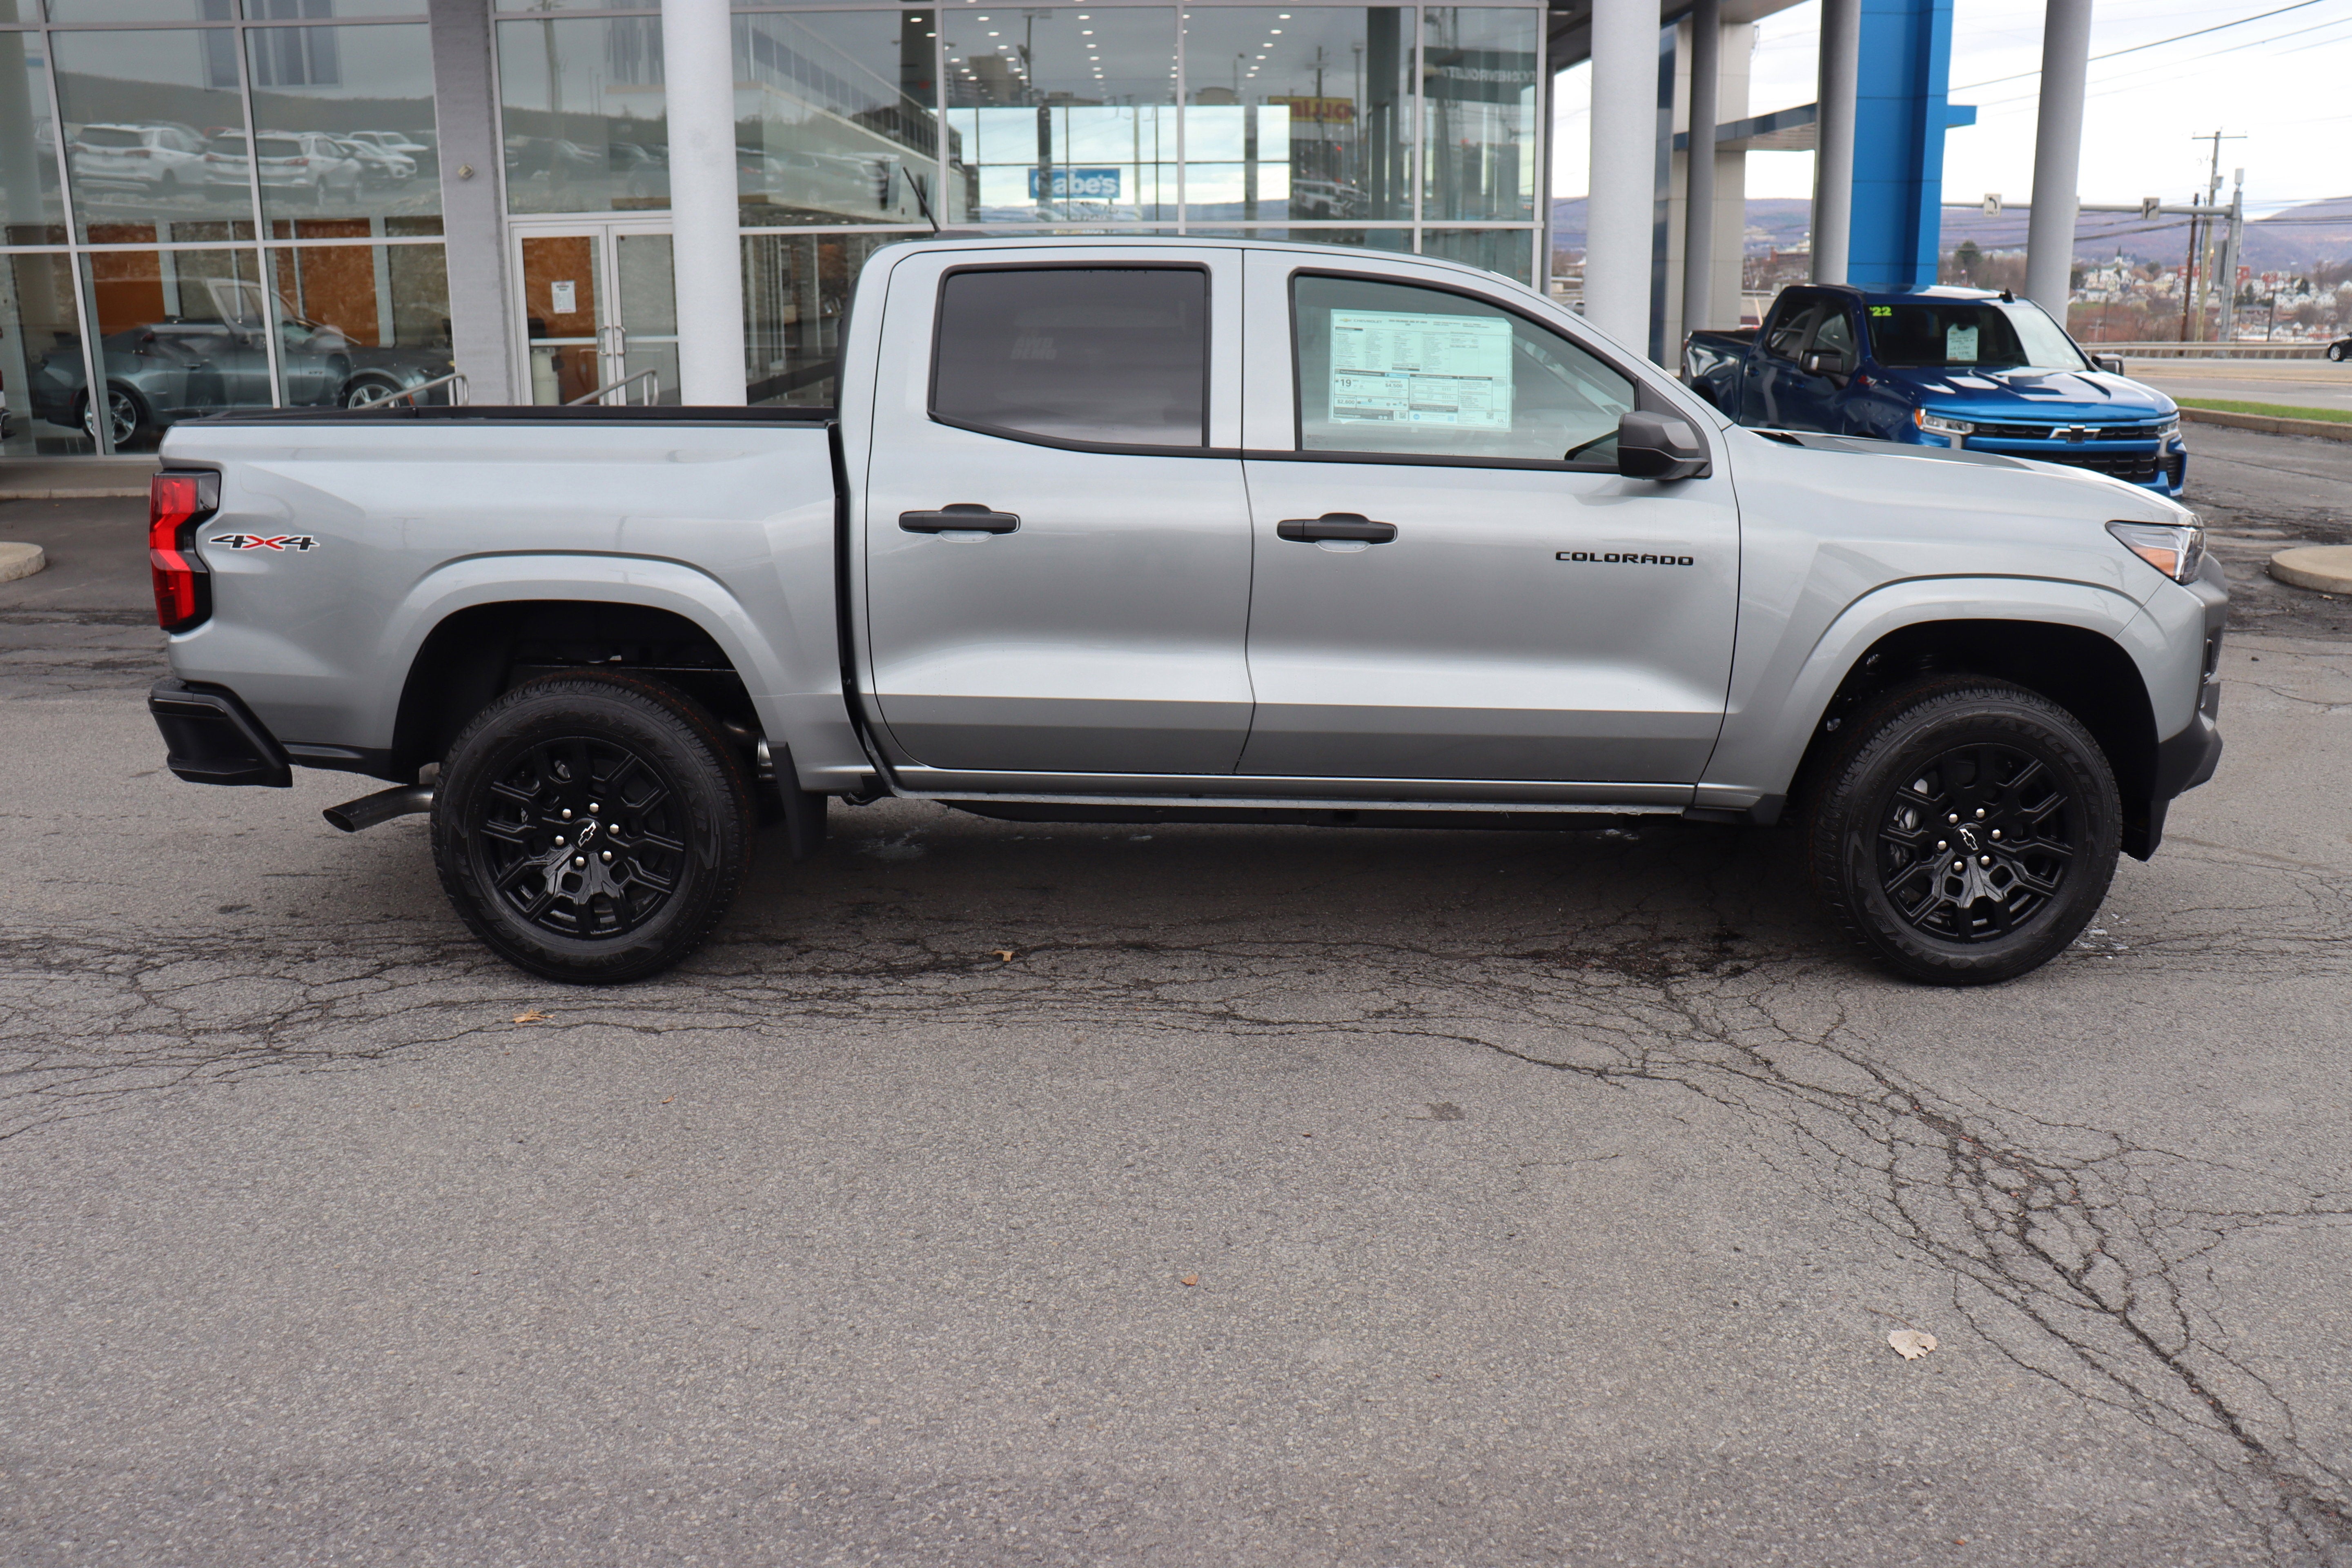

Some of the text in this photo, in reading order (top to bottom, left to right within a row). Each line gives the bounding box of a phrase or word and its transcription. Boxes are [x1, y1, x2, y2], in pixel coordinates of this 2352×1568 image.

[1340, 379, 1352, 387] 19
[1555, 551, 1694, 566] COLORADO
[1950, 716, 2099, 820] WRANGLER
